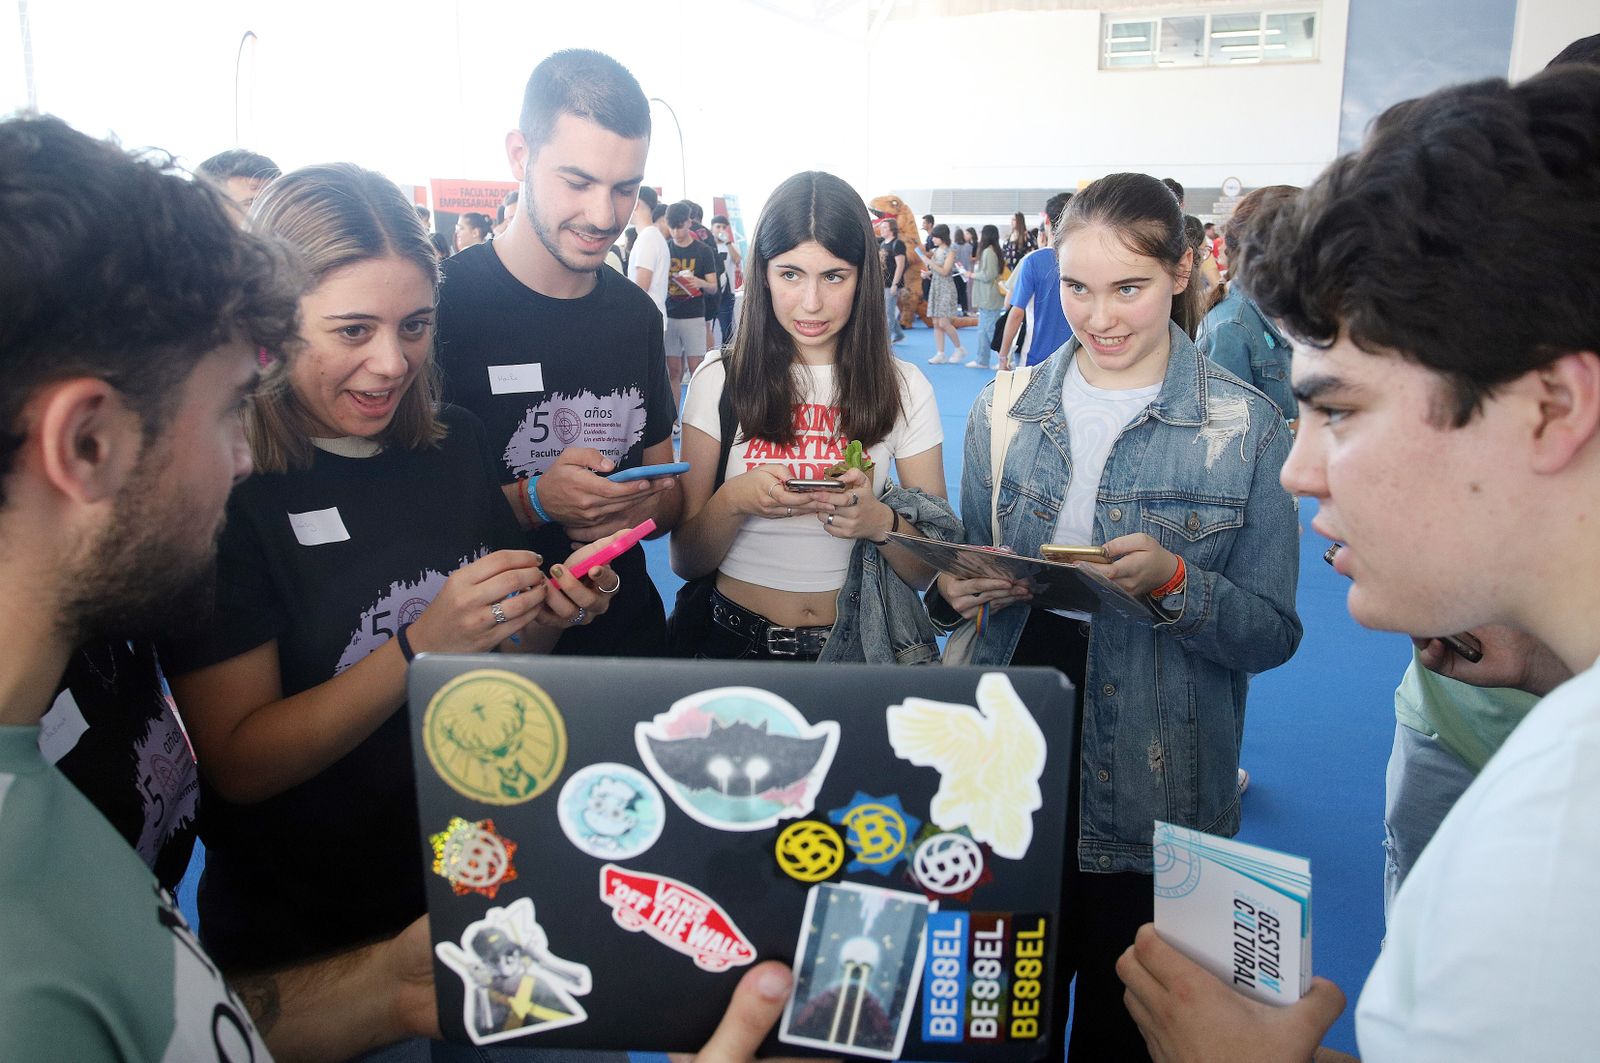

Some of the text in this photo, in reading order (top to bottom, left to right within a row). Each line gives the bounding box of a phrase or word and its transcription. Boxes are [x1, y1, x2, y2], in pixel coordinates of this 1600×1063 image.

[439, 197, 502, 208] EMPRESARIALES
[460, 187, 499, 198] FACULTAD
[584, 406, 613, 419] años
[653, 880, 713, 922] VANS
[650, 903, 691, 941] THE
[1233, 898, 1256, 989] CULTURAL
[1258, 911, 1285, 993] GESTIÓN
